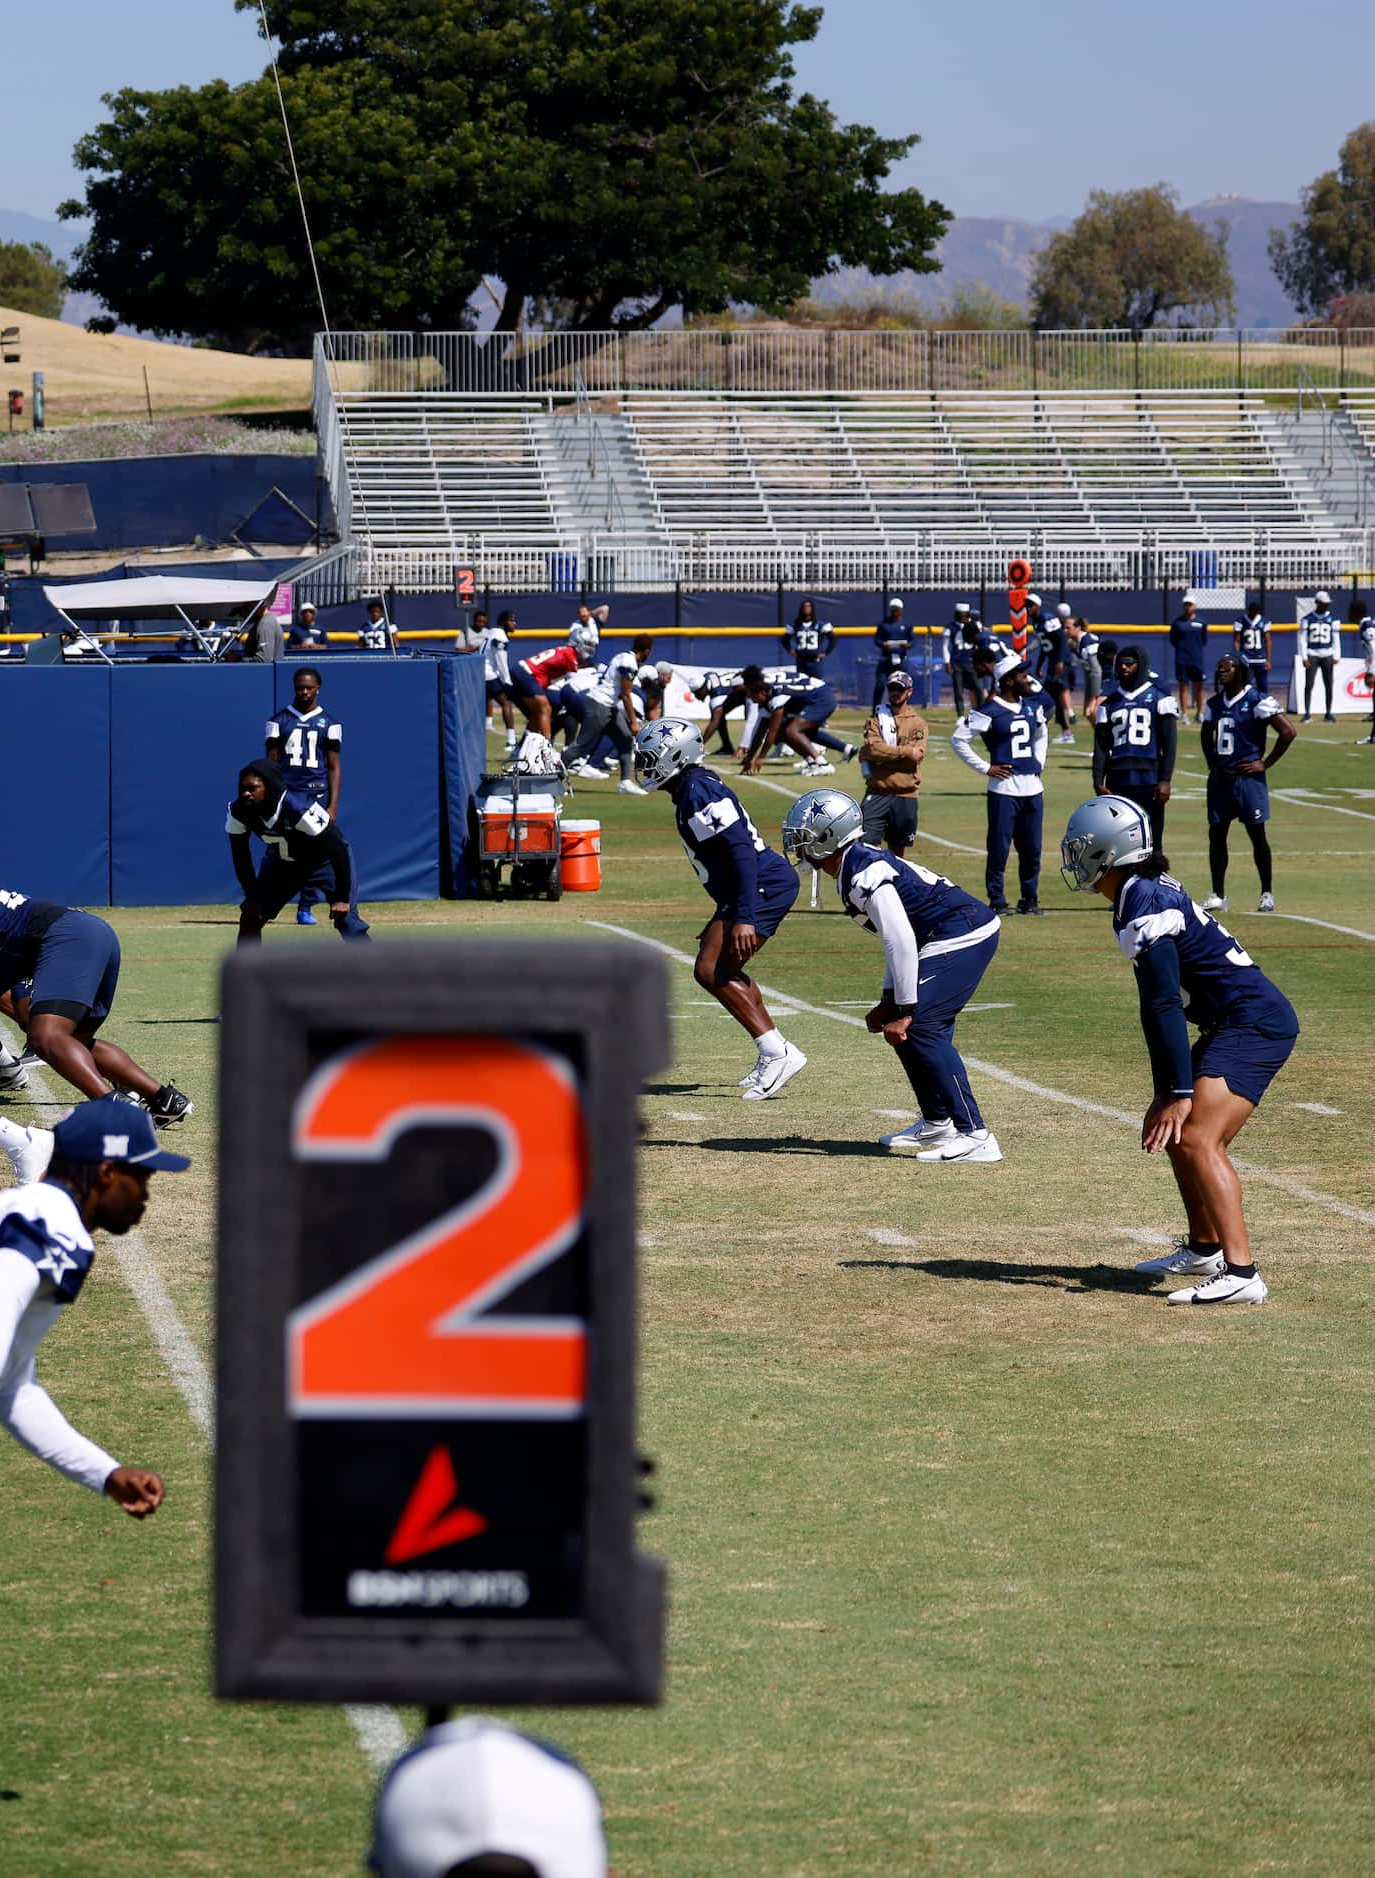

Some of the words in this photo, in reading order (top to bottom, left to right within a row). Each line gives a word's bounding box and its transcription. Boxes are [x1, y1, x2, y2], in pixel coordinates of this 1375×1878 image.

[457, 569, 475, 593] 2
[796, 630, 819, 651] 33
[1243, 629, 1263, 650] 31
[1308, 622, 1332, 644] 29
[1010, 719, 1033, 759] 2
[1111, 707, 1152, 746] 28
[1217, 717, 1235, 756] 6
[284, 728, 320, 768] 41
[261, 834, 296, 861] 7
[286, 1034, 591, 1424] 2
